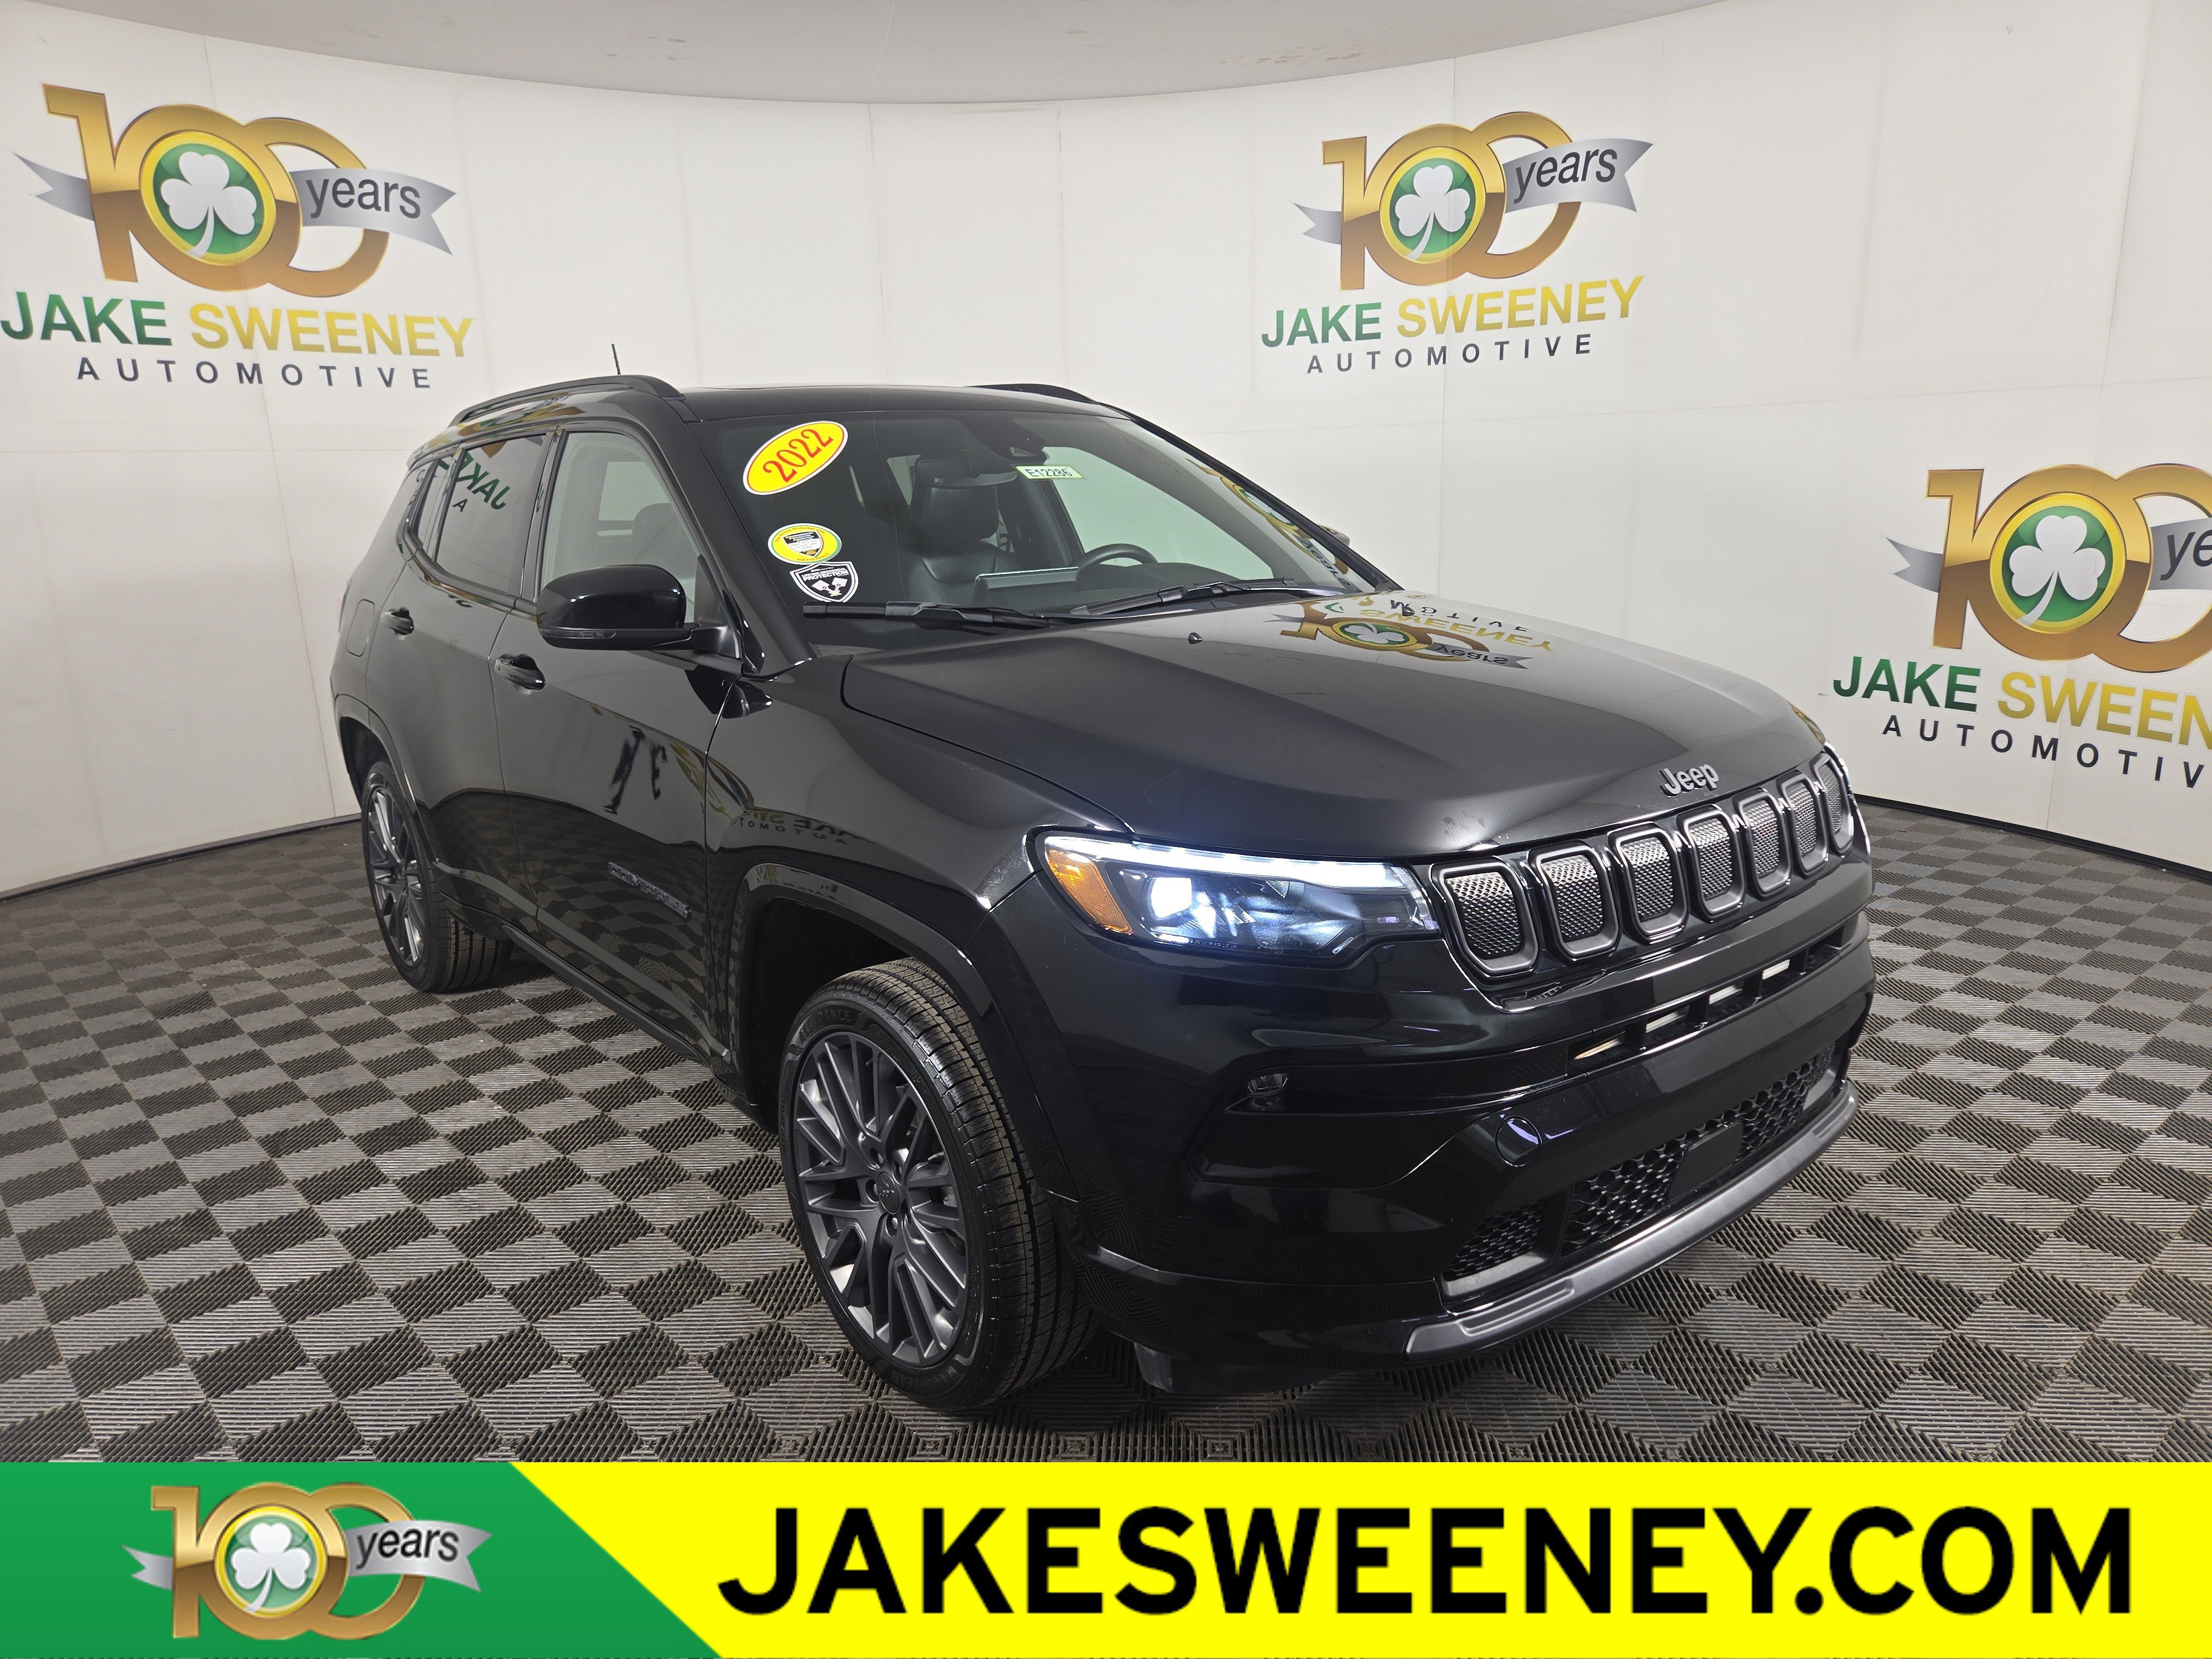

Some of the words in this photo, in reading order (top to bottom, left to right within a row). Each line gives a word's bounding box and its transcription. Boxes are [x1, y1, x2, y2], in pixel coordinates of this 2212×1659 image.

[41, 82, 390, 297] 100
[306, 177, 421, 219] years
[1322, 111, 1581, 291] 100
[1513, 148, 1617, 204] years
[1, 291, 172, 346] JAKE
[190, 303, 472, 358] SWEENEY
[1262, 302, 1381, 348] JAKE
[1397, 275, 1644, 338] SWEENEY
[78, 357, 430, 389] AUTOMOTIVE
[1307, 334, 1591, 375] AUTOMOTIVE
[763, 429, 834, 483] 2022
[1025, 468, 1072, 477] E12286
[802, 570, 849, 581] PROTECTION
[1833, 656, 1981, 713] JAKE
[1882, 715, 2205, 788] AUTOMOTIV
[1660, 764, 1719, 796] Jeep
